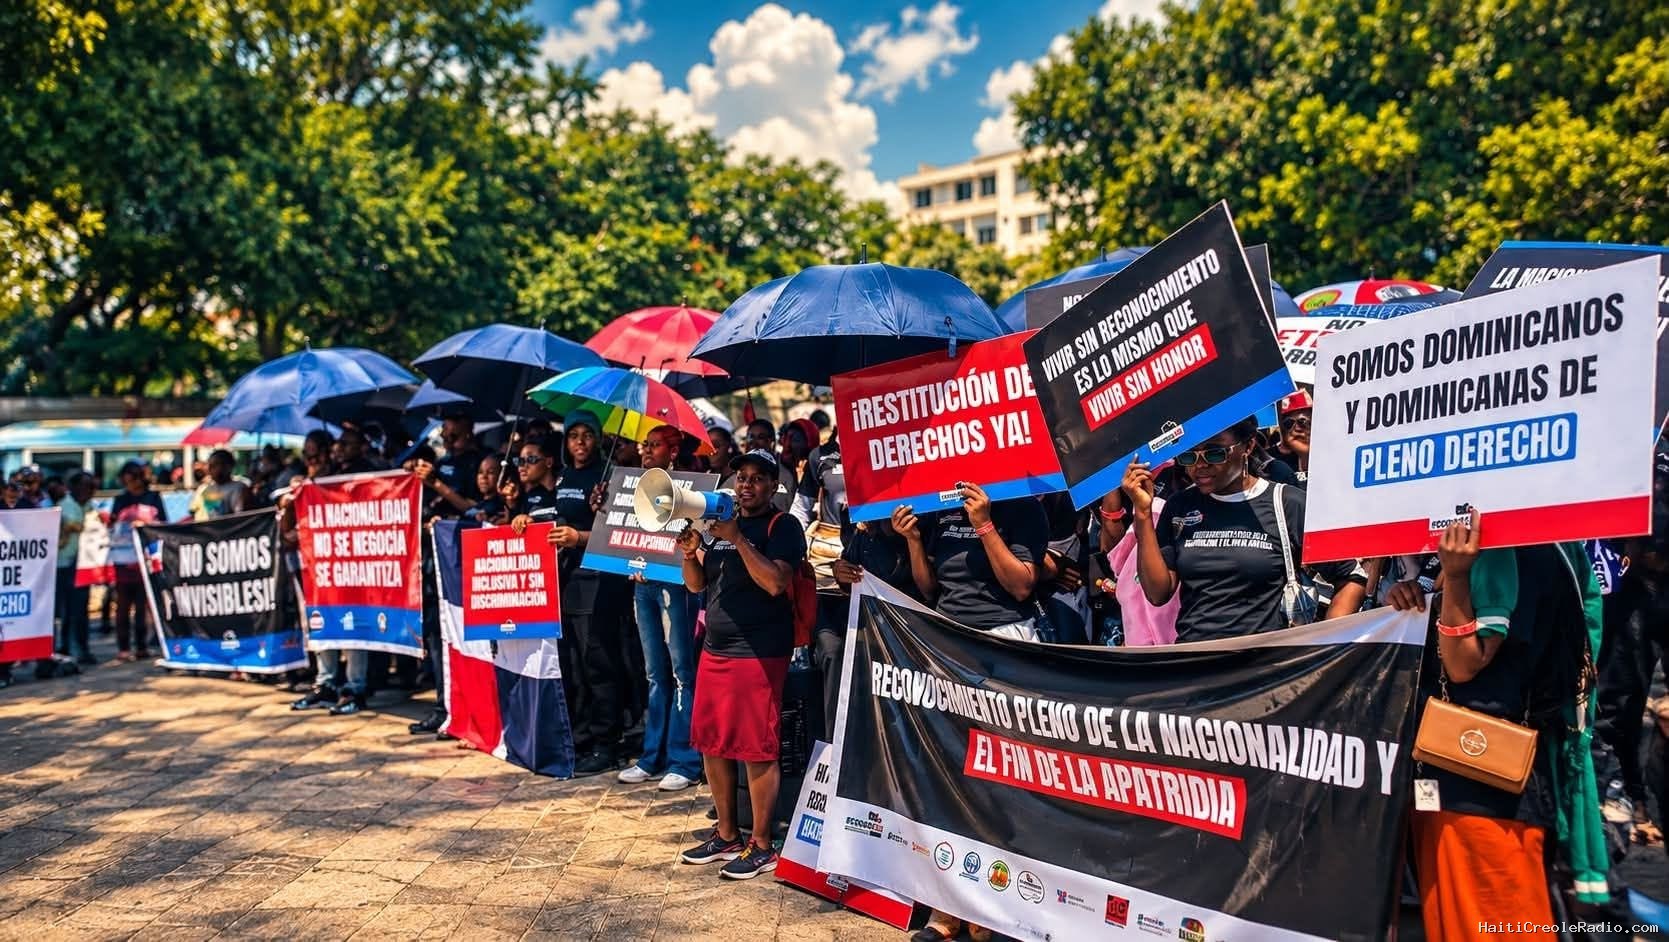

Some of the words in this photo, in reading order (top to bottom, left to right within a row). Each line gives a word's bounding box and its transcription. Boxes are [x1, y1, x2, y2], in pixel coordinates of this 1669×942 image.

[1041, 343, 1077, 383] VIVIR
[1074, 327, 1100, 360] SIN
[1097, 248, 1221, 345] RECONOCIMIENTO
[1331, 338, 1415, 389] SOMOS
[1422, 293, 1624, 369] DOMINICANOS
[1073, 365, 1093, 396] ES
[1092, 353, 1112, 384] LO
[1111, 324, 1165, 372] MISMO
[1163, 300, 1198, 338] QUE
[1087, 382, 1127, 423] VIVIR
[1124, 366, 1152, 400] SIN
[1150, 333, 1208, 385] HONOR
[851, 367, 1000, 432] ¡RESTITUCIÓN
[1004, 363, 1037, 401] DE
[1346, 399, 1360, 434] Y
[1366, 363, 1549, 432] DOMINICANAS
[1560, 354, 1598, 398] DE
[868, 419, 987, 471] DERECHOS
[990, 410, 1032, 449] YA!
[1359, 438, 1435, 483] PLENO
[1443, 417, 1570, 471] DERECHO
[308, 504, 324, 529] LA
[313, 532, 332, 558] NO
[334, 530, 351, 557] SE
[487, 539, 505, 555] POR
[506, 537, 525, 554] UNA
[3, 566, 22, 586] DE
[178, 543, 203, 578] NO
[205, 535, 271, 576] SOMOS
[315, 561, 332, 588] SE
[333, 560, 403, 588] GARANTIZA
[471, 574, 518, 592] INCLUSIVA
[519, 572, 527, 589] Y
[528, 571, 545, 588] SIN
[474, 554, 541, 574] NACIONALIDAD
[470, 588, 548, 610] DISCRIMINACIÓN
[871, 660, 1012, 730] RECONOCIMIENTO
[1013, 694, 1081, 743] PLENO
[1083, 705, 1118, 749] DE
[1119, 708, 1158, 754] LA
[1158, 711, 1366, 790] NACIONALIDAD
[1375, 740, 1400, 795] Y
[973, 733, 998, 774] EL
[999, 740, 1034, 783] FIN
[1033, 750, 1066, 791] DE
[1064, 756, 1100, 798] LA
[1099, 762, 1236, 829] APATRIDIA
